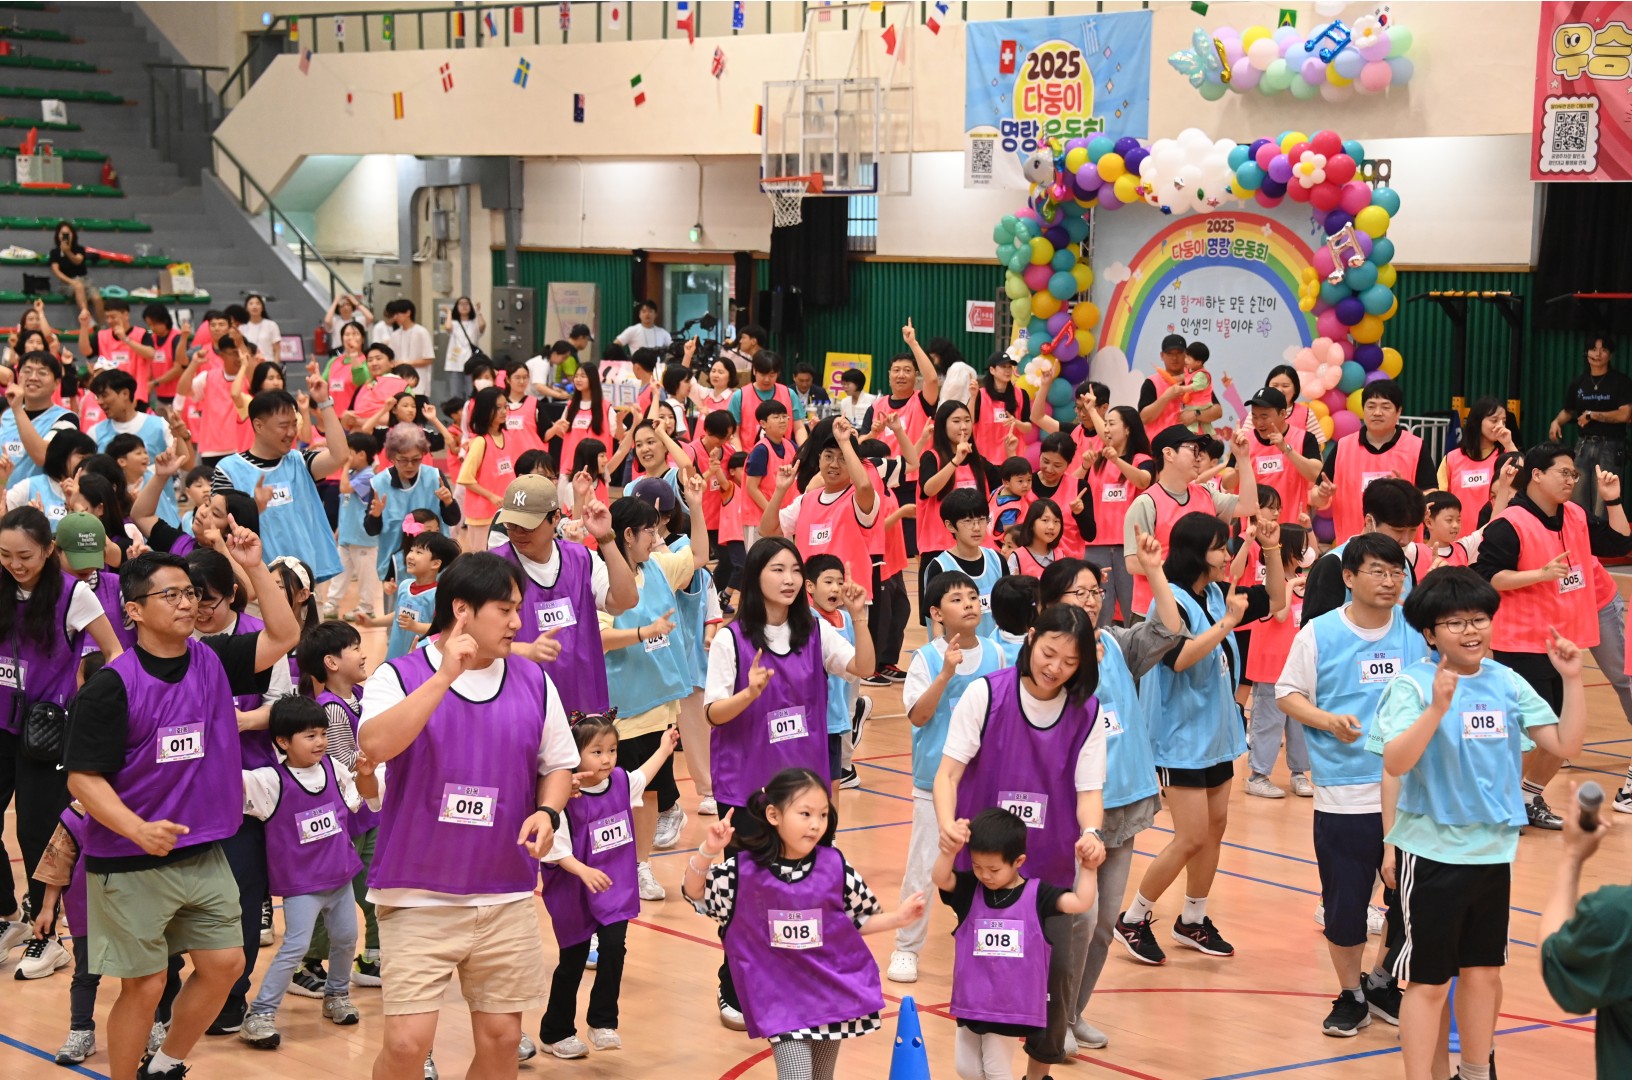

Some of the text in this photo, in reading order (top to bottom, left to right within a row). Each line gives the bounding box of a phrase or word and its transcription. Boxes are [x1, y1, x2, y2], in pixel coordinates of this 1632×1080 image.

[1027, 50, 1081, 81] 2025
[1023, 82, 1082, 116] 다둥이
[1001, 120, 1039, 152] 명랑
[1207, 220, 1234, 233] 2025
[1172, 238, 1269, 261] 다둥이 명랑 운동회
[1160, 295, 1276, 314] 우리 함께하는 모든 순간이
[1181, 318, 1253, 339] 인생의 보물이야
[1468, 475, 1482, 483] 001
[513, 490, 527, 506] NY
[1108, 490, 1122, 498] 007
[1563, 574, 1579, 586] 005
[543, 611, 564, 623] 010
[1369, 662, 1393, 675] 018
[777, 719, 796, 733] 017
[1471, 716, 1495, 729] 018
[171, 738, 193, 752] 017
[457, 800, 484, 815] 018
[1008, 805, 1033, 818] 018
[311, 819, 331, 833] 010
[602, 826, 622, 842] 017
[783, 925, 809, 940] 018
[986, 933, 1010, 947] 018
